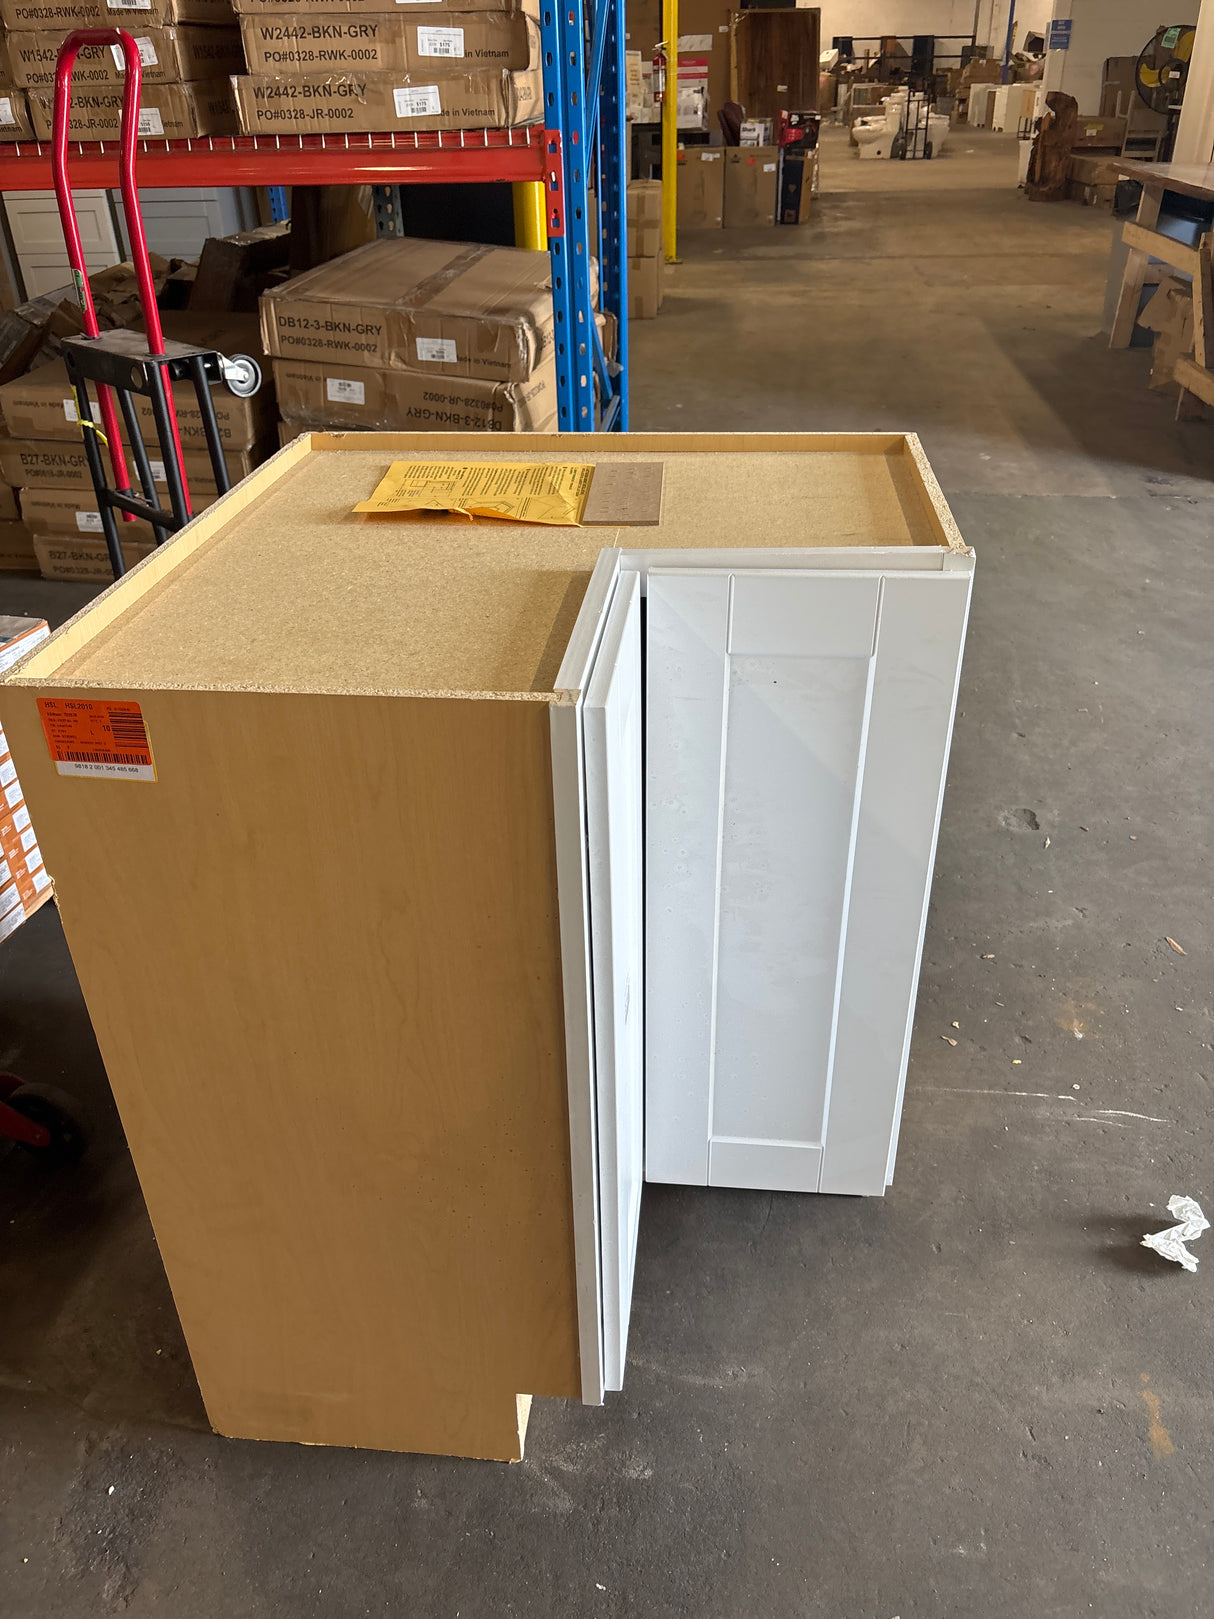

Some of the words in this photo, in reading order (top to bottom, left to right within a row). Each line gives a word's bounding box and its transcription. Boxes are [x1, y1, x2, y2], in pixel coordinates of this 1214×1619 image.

[16, 6, 101, 19] PO#0328-RWK-0002
[260, 24, 378, 40] W2442-BKN-GRY
[264, 49, 377, 63] PO#0328-RWK-0002
[475, 50, 509, 58] Vietnam
[253, 83, 367, 99] W2442-BKN-GRY
[256, 107, 354, 121] PO#0328-JR-0002
[452, 108, 460, 116] in
[462, 107, 495, 117] Vietnam
[278, 316, 382, 335] DB12-3-BKN-GRY
[281, 335, 377, 352] PO#0328-RWK-0002
[423, 391, 503, 412] PO#0328-JR-0002
[406, 406, 502, 431] DB12-3-BKN-GRY
